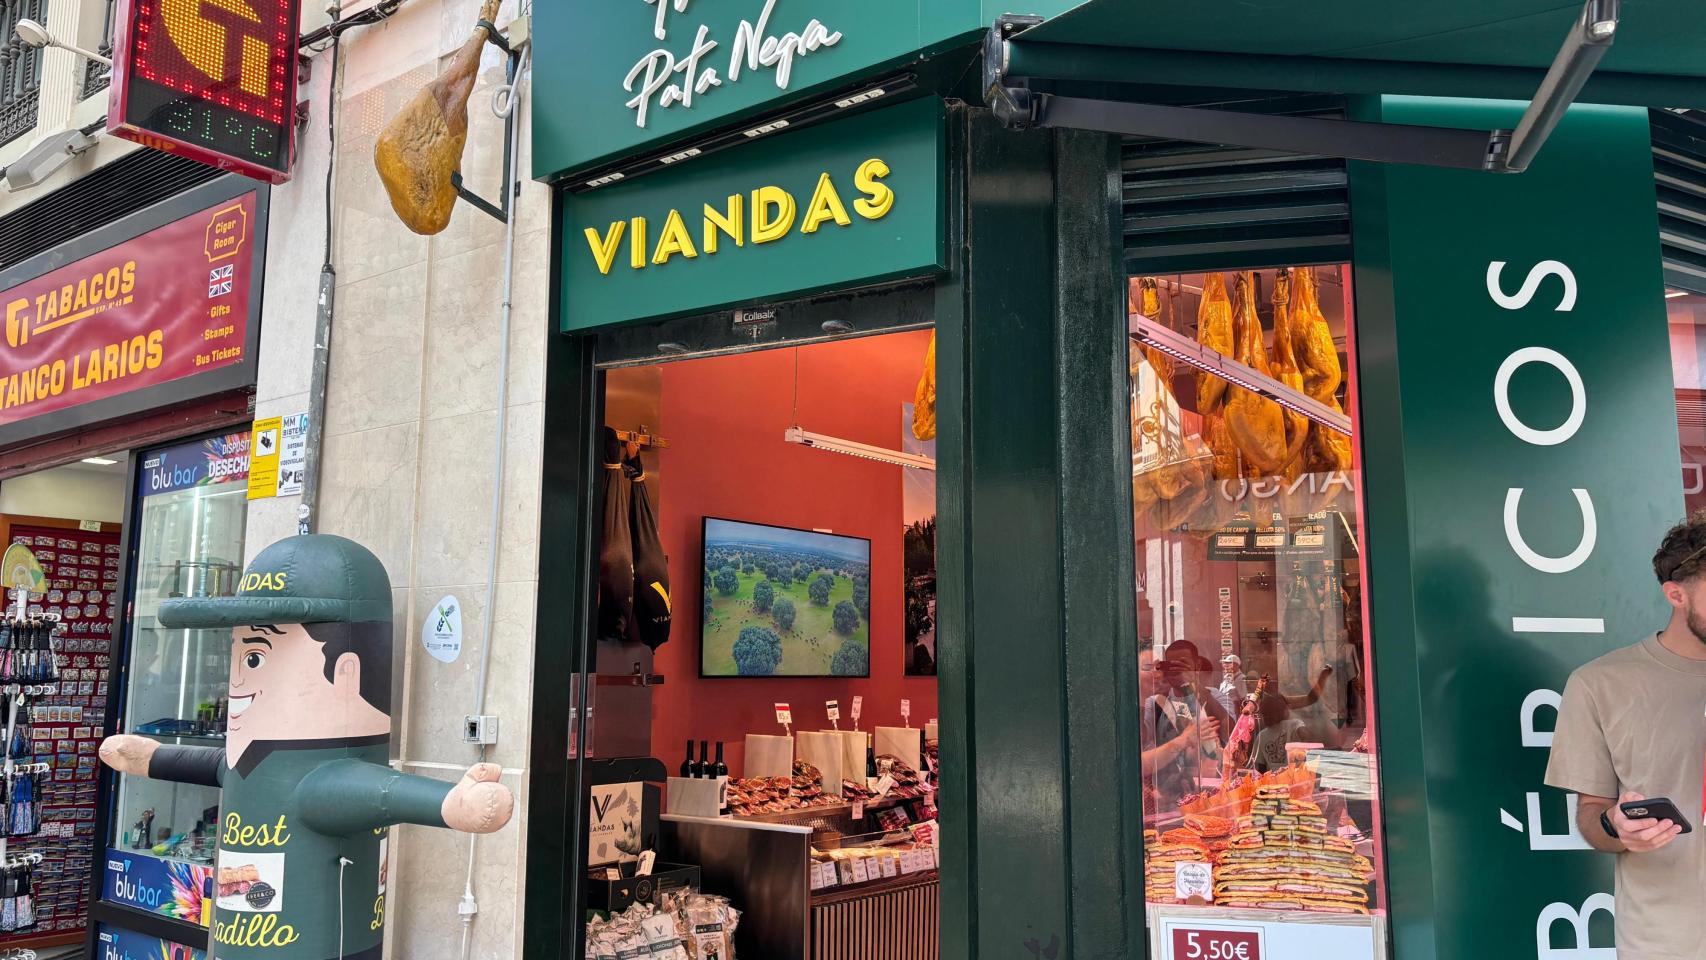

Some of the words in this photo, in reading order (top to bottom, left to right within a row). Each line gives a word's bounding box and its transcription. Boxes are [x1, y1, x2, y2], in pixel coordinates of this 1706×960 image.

[621, 24, 721, 128] Pata
[728, 0, 843, 89] Negra
[215, 220, 237, 235] Cigar
[584, 158, 894, 275] VIANDAS
[214, 234, 235, 250] Room
[35, 260, 136, 325] TABACOS
[210, 305, 231, 318] Gifts
[204, 325, 234, 341] Stamps
[0, 358, 64, 411] TANCO
[72, 329, 163, 390] LARIOS
[195, 353, 210, 367] Bus
[212, 346, 241, 362] Tickets
[283, 417, 296, 428] MM
[151, 464, 198, 490] blu.bar
[224, 812, 291, 847] Best
[115, 873, 161, 907] blu.bar
[1186, 932, 1250, 960] 5,50€
